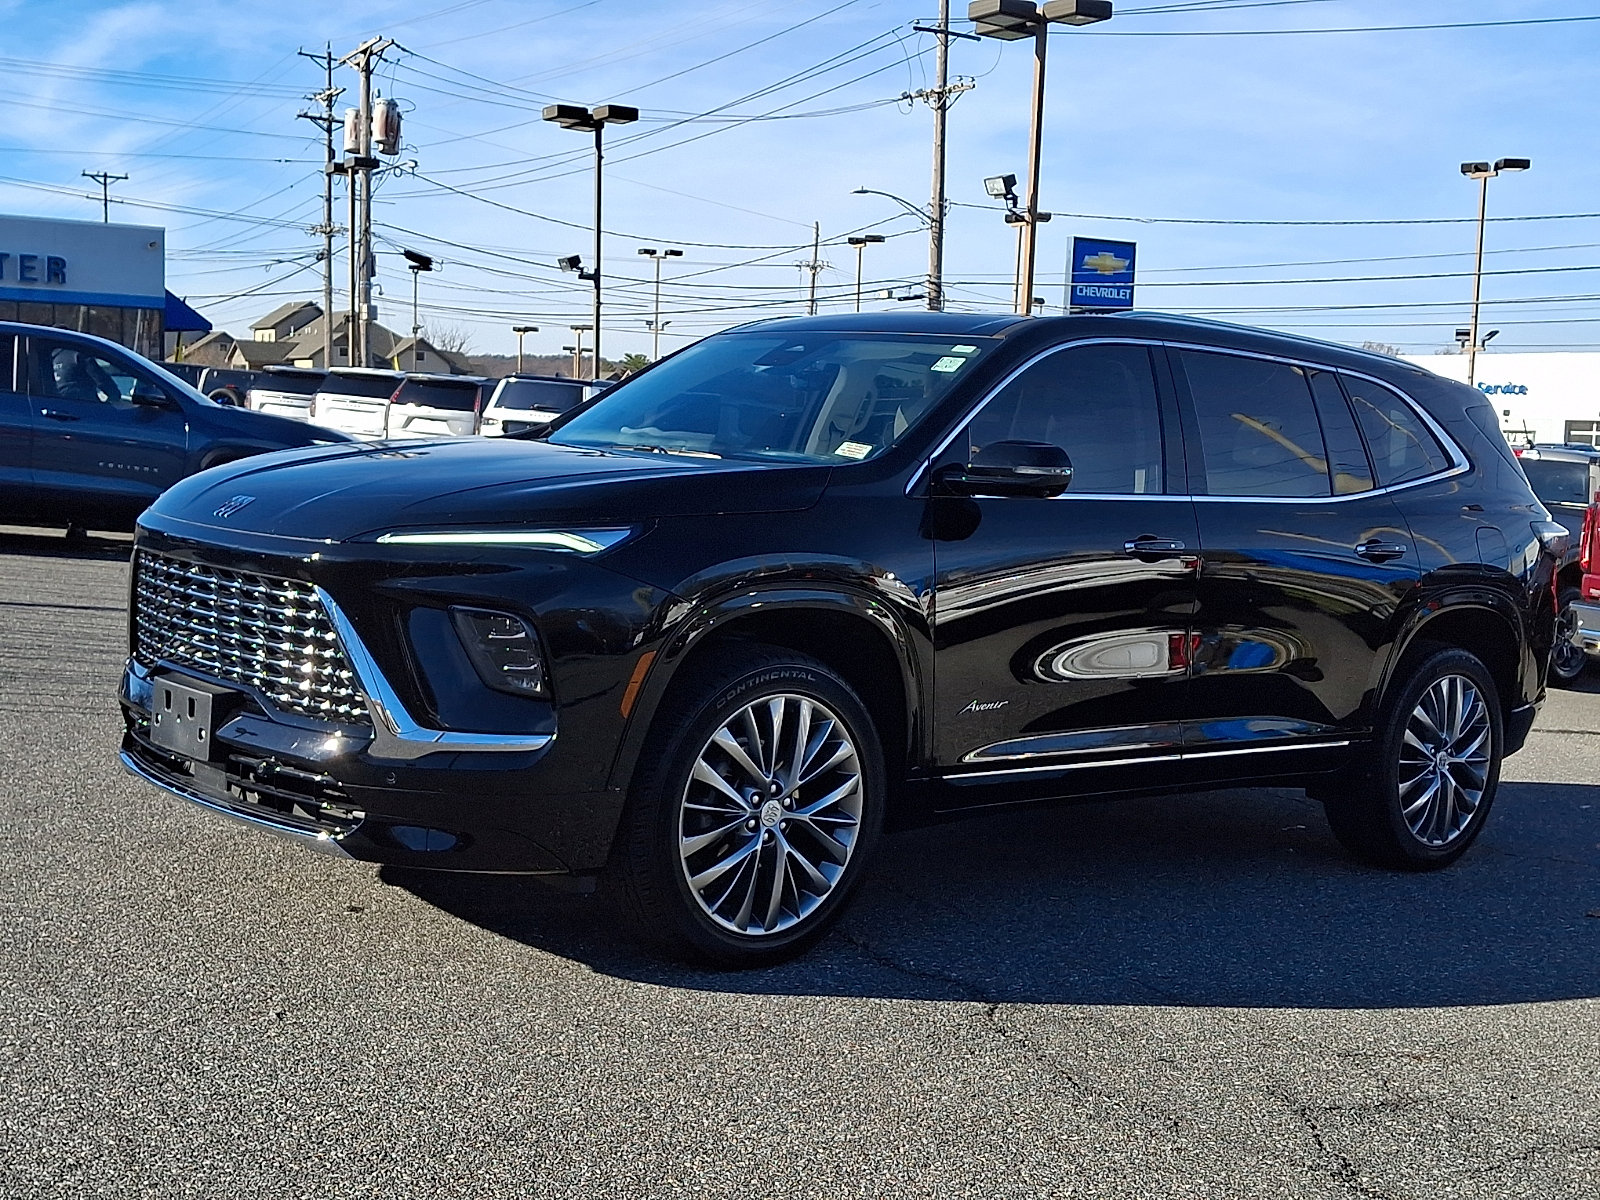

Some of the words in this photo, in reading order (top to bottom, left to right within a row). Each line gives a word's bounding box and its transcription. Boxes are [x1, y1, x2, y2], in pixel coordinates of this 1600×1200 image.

[1076, 285, 1131, 300] CHEVROLET
[1477, 381, 1529, 395] Service
[716, 670, 817, 709] CONTINENTAL
[957, 699, 1009, 716] Avenir
